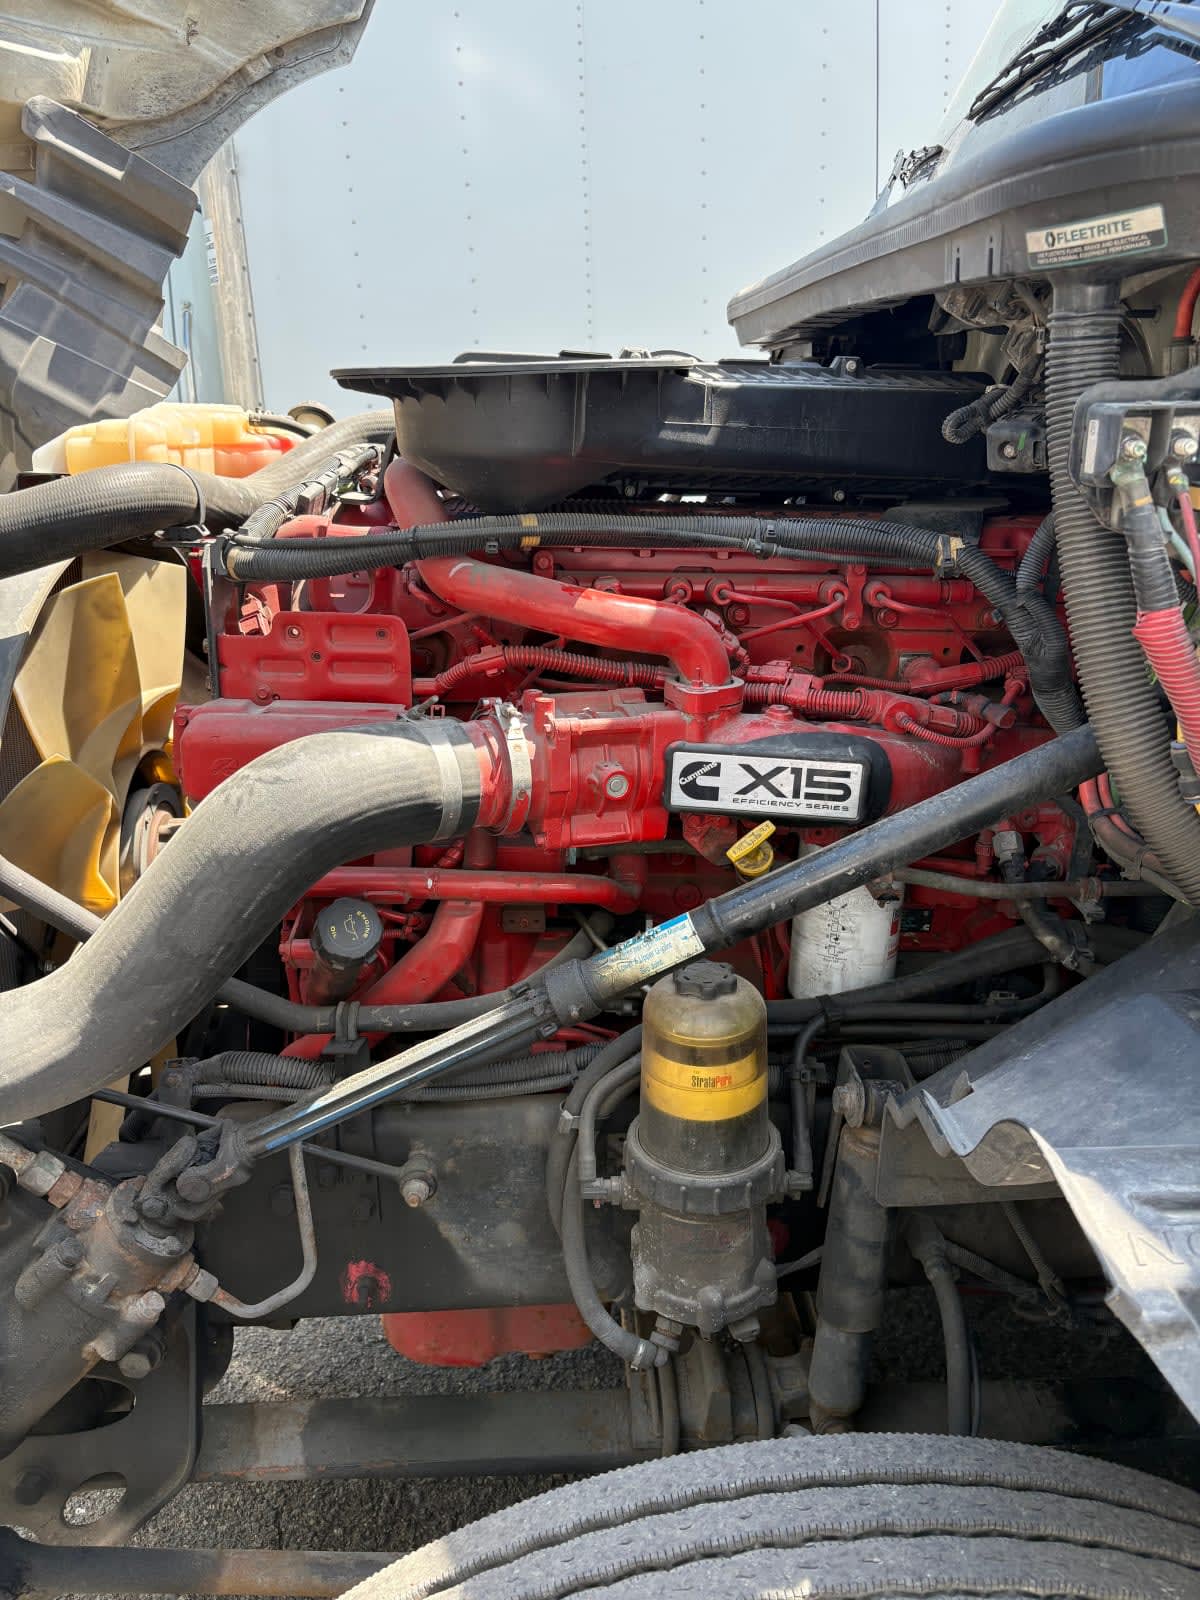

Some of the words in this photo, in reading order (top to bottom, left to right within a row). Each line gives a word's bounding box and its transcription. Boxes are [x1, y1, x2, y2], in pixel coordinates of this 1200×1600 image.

[1057, 218, 1134, 244] FLEETRITE
[680, 760, 718, 785] Cummins
[734, 763, 852, 802] X15
[732, 798, 801, 807] EFFICIENCY
[805, 803, 849, 812] SERIES
